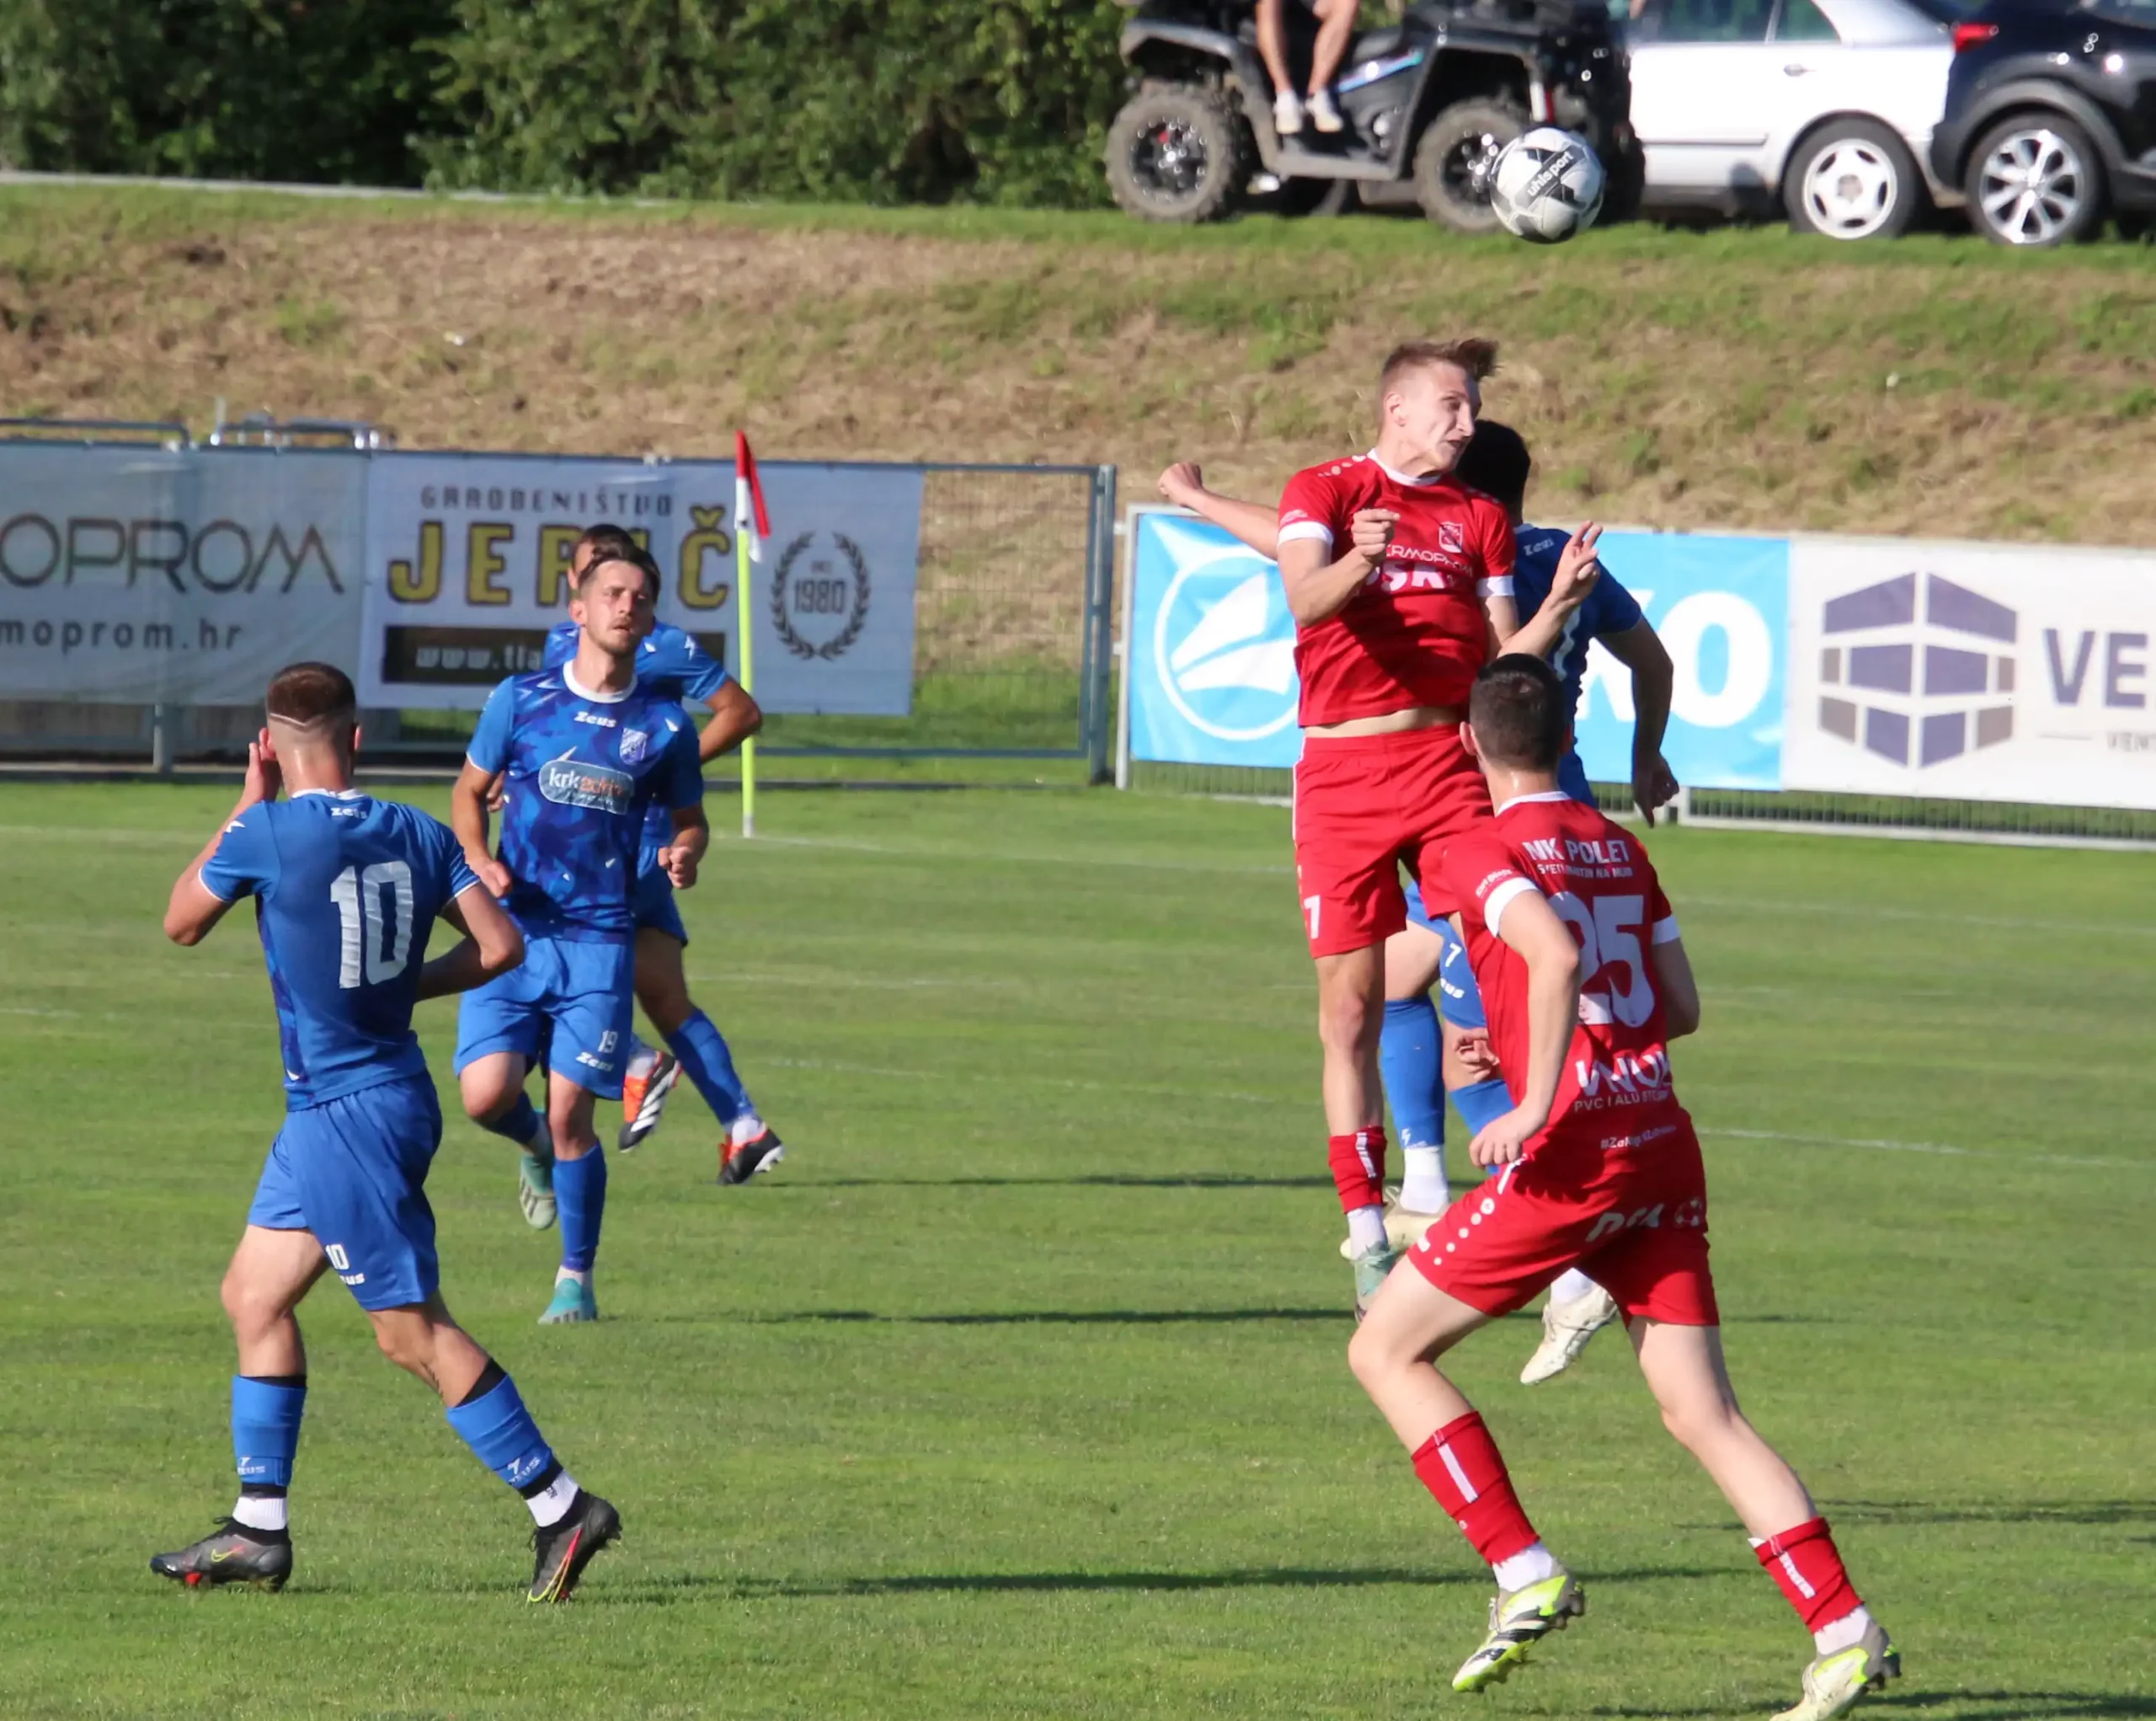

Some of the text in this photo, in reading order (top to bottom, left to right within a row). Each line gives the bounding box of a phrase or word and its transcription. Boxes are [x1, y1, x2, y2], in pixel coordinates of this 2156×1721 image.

[1527, 151, 1574, 196] uhlsport
[387, 503, 731, 611] JERČ
[794, 578, 846, 615] 1980
[0, 617, 243, 655] moprom.hr
[574, 711, 617, 728] Zeus
[1523, 837, 1630, 864] NK POLET
[331, 860, 414, 990] 10
[1444, 943, 1463, 968] 7
[1547, 890, 1655, 1028] 25
[1574, 1098, 1604, 1113] PVC
[1614, 1092, 1641, 1106] ALU
